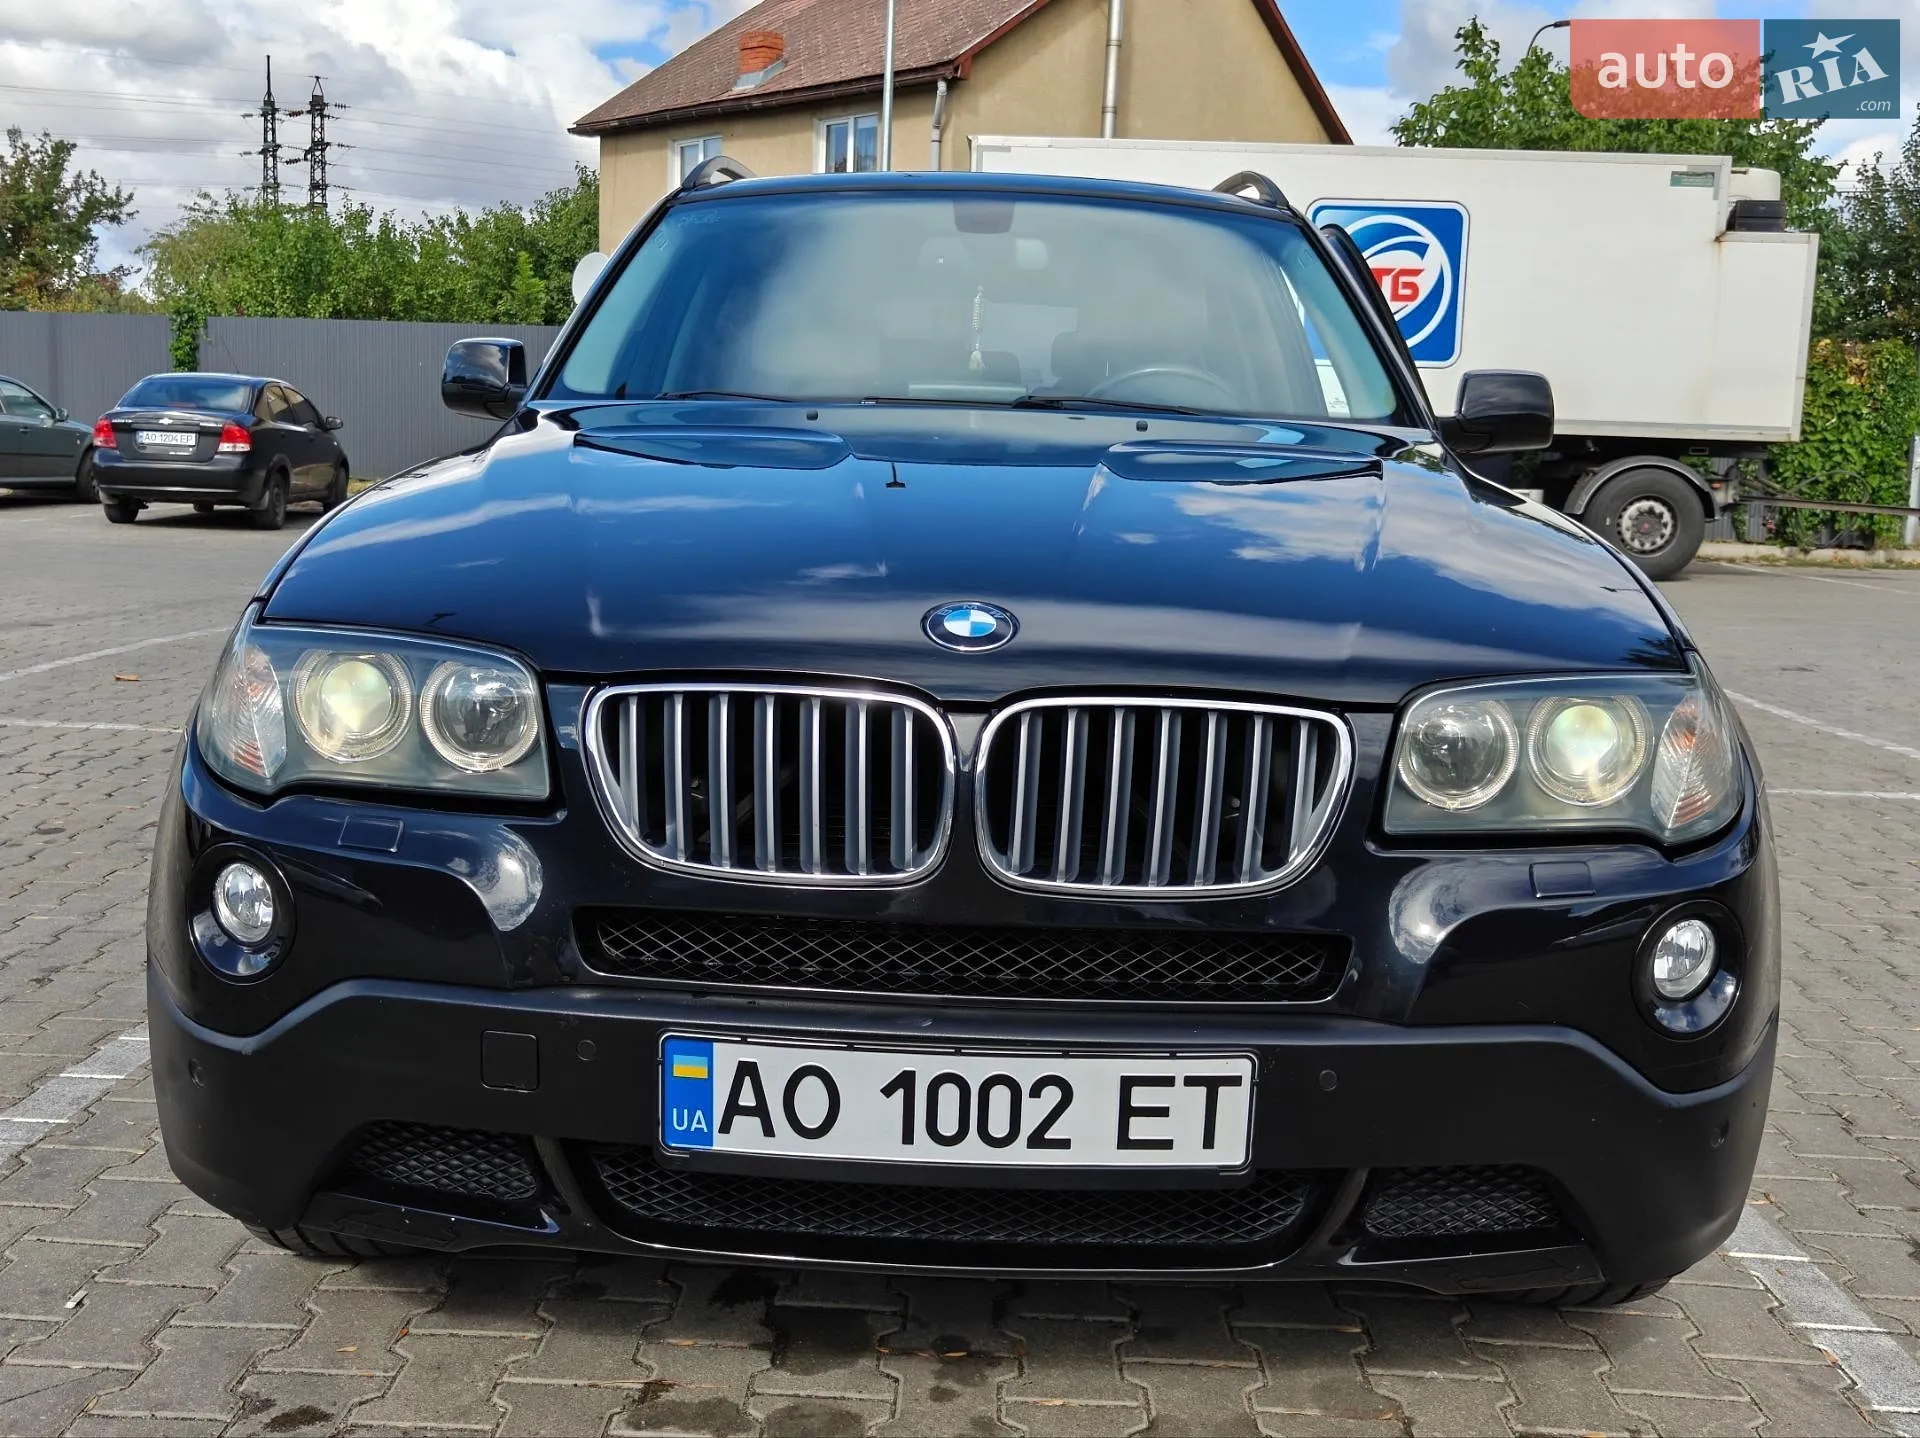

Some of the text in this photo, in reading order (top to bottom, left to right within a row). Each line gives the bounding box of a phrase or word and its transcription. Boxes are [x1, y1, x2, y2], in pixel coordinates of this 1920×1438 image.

[672, 1108, 708, 1133] UA
[717, 1060, 1243, 1150] AO 1002 ET
